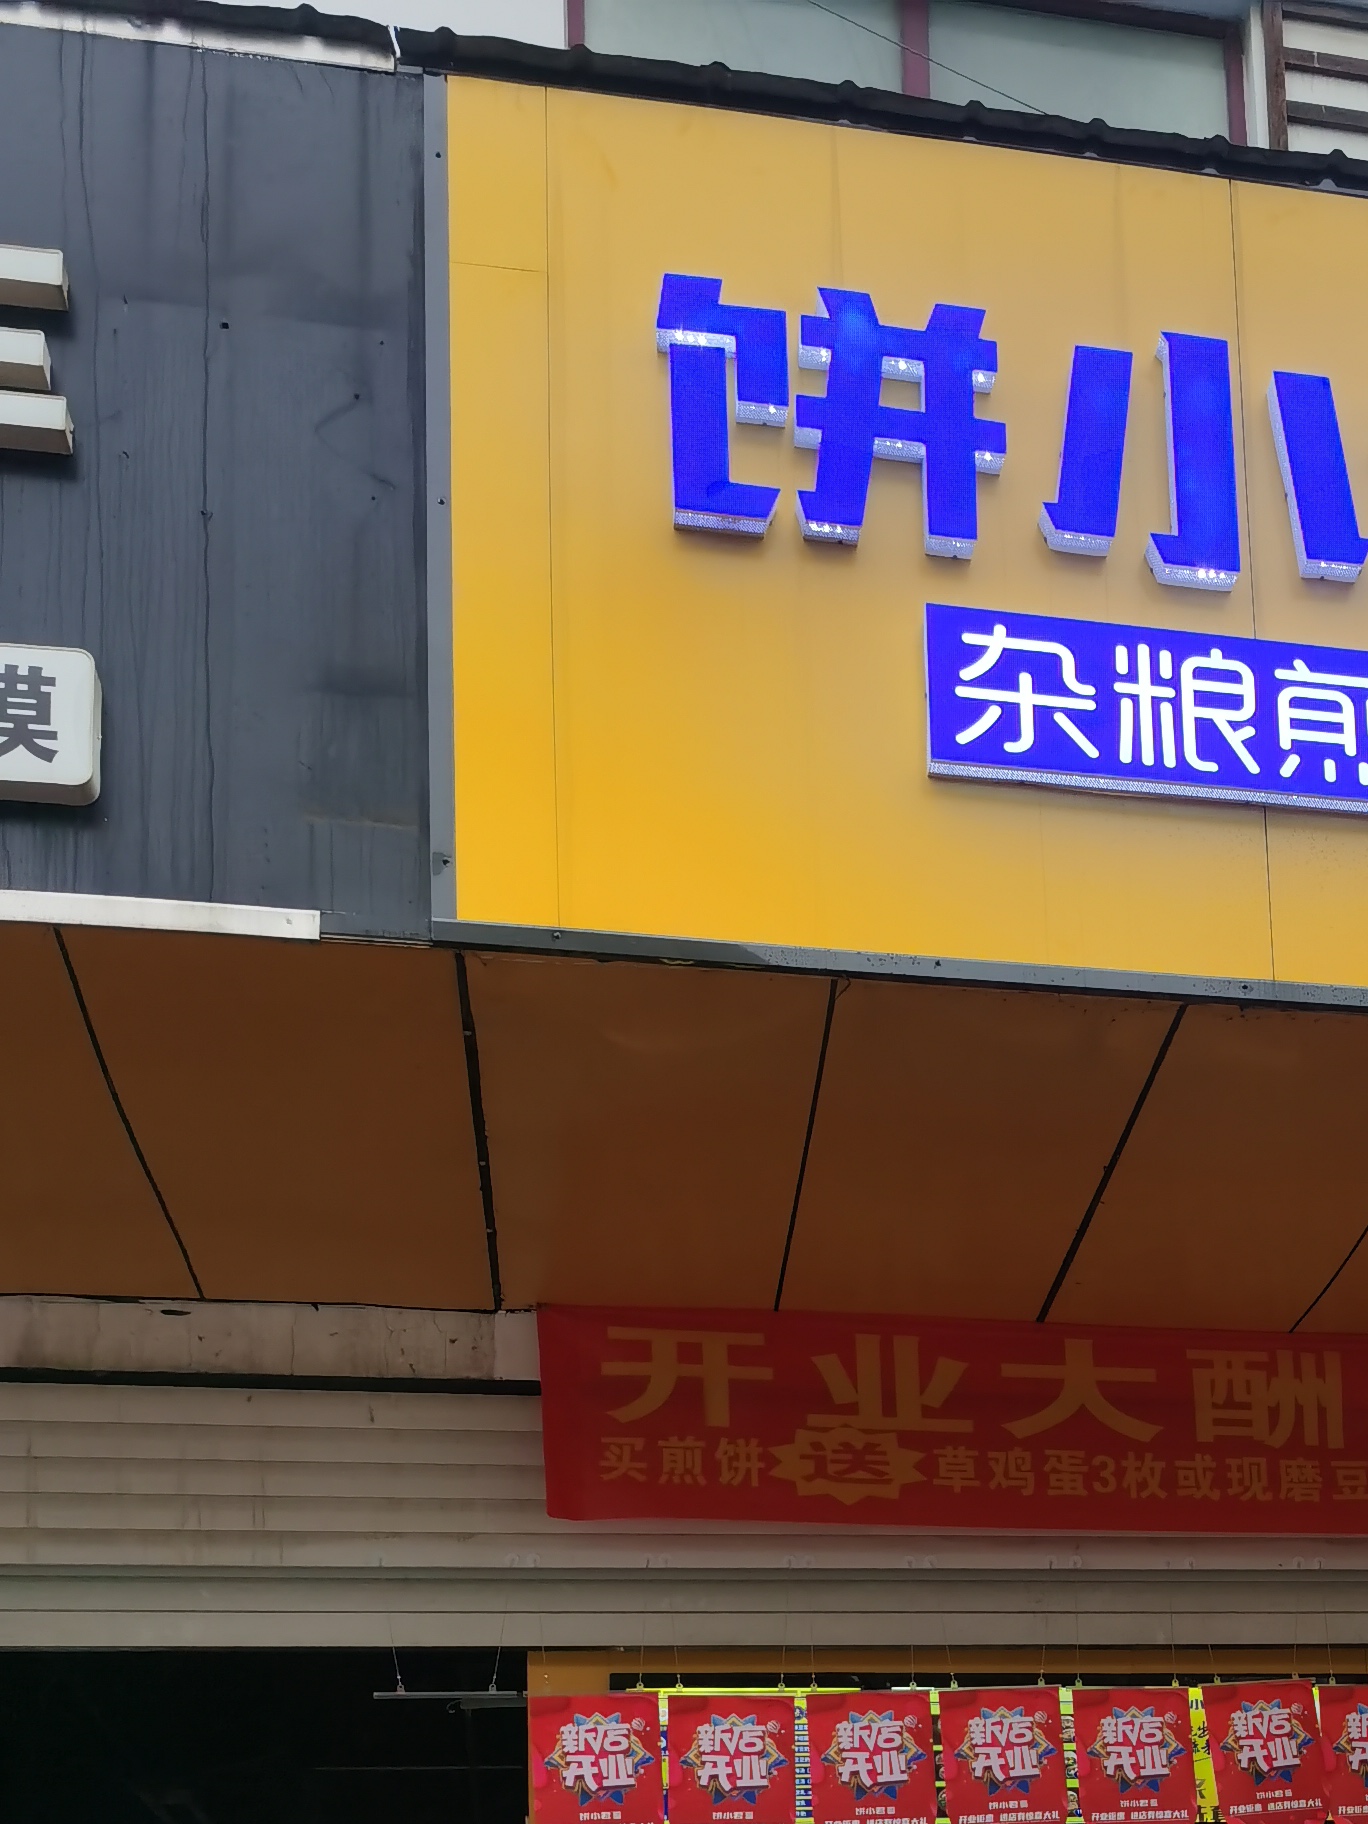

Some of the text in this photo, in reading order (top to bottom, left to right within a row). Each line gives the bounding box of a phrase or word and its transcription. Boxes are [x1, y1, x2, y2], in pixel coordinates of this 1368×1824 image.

[560, 1722, 630, 1755] 新店
[697, 1724, 766, 1756] 新店
[836, 1721, 904, 1752] 新店
[968, 1717, 1034, 1747] 新店
[1101, 1716, 1164, 1746] 新店
[1232, 1707, 1291, 1739] 新店
[838, 1750, 909, 1787] 开业
[972, 1746, 1040, 1781] 开业
[1103, 1745, 1170, 1780] 开业
[1237, 1737, 1301, 1773] 开业
[563, 1754, 635, 1792] 开业
[698, 1755, 769, 1791] 开业
